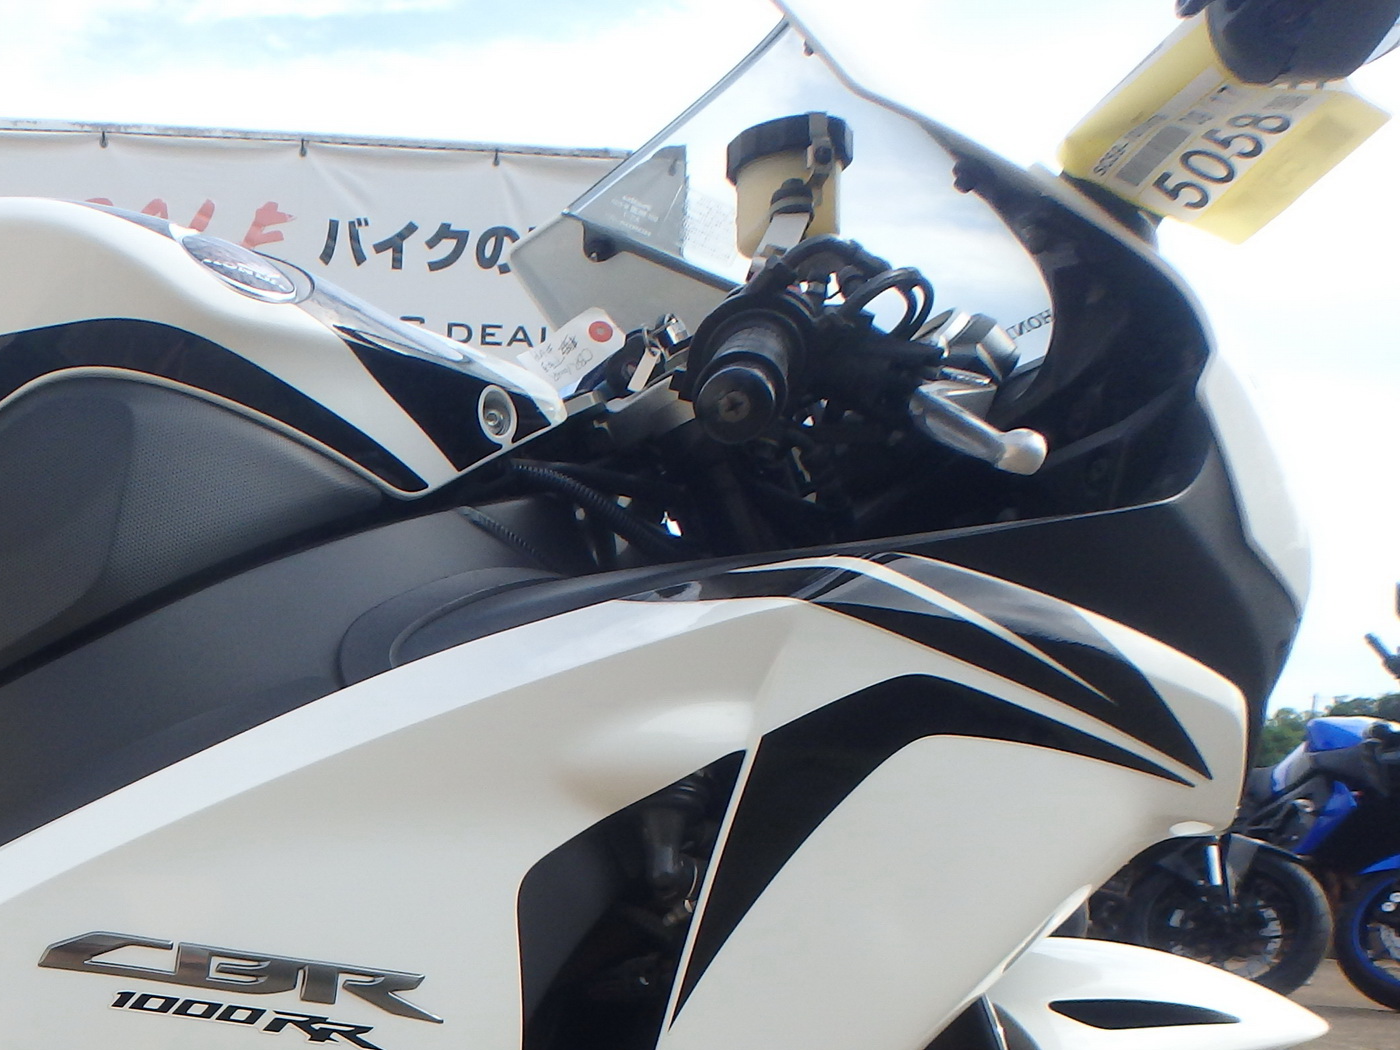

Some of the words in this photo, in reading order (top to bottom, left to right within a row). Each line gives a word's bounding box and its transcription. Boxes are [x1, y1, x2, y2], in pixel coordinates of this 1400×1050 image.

[1151, 113, 1292, 211] 5058
[318, 216, 537, 275] バイクの
[37, 929, 445, 1024] CBR
